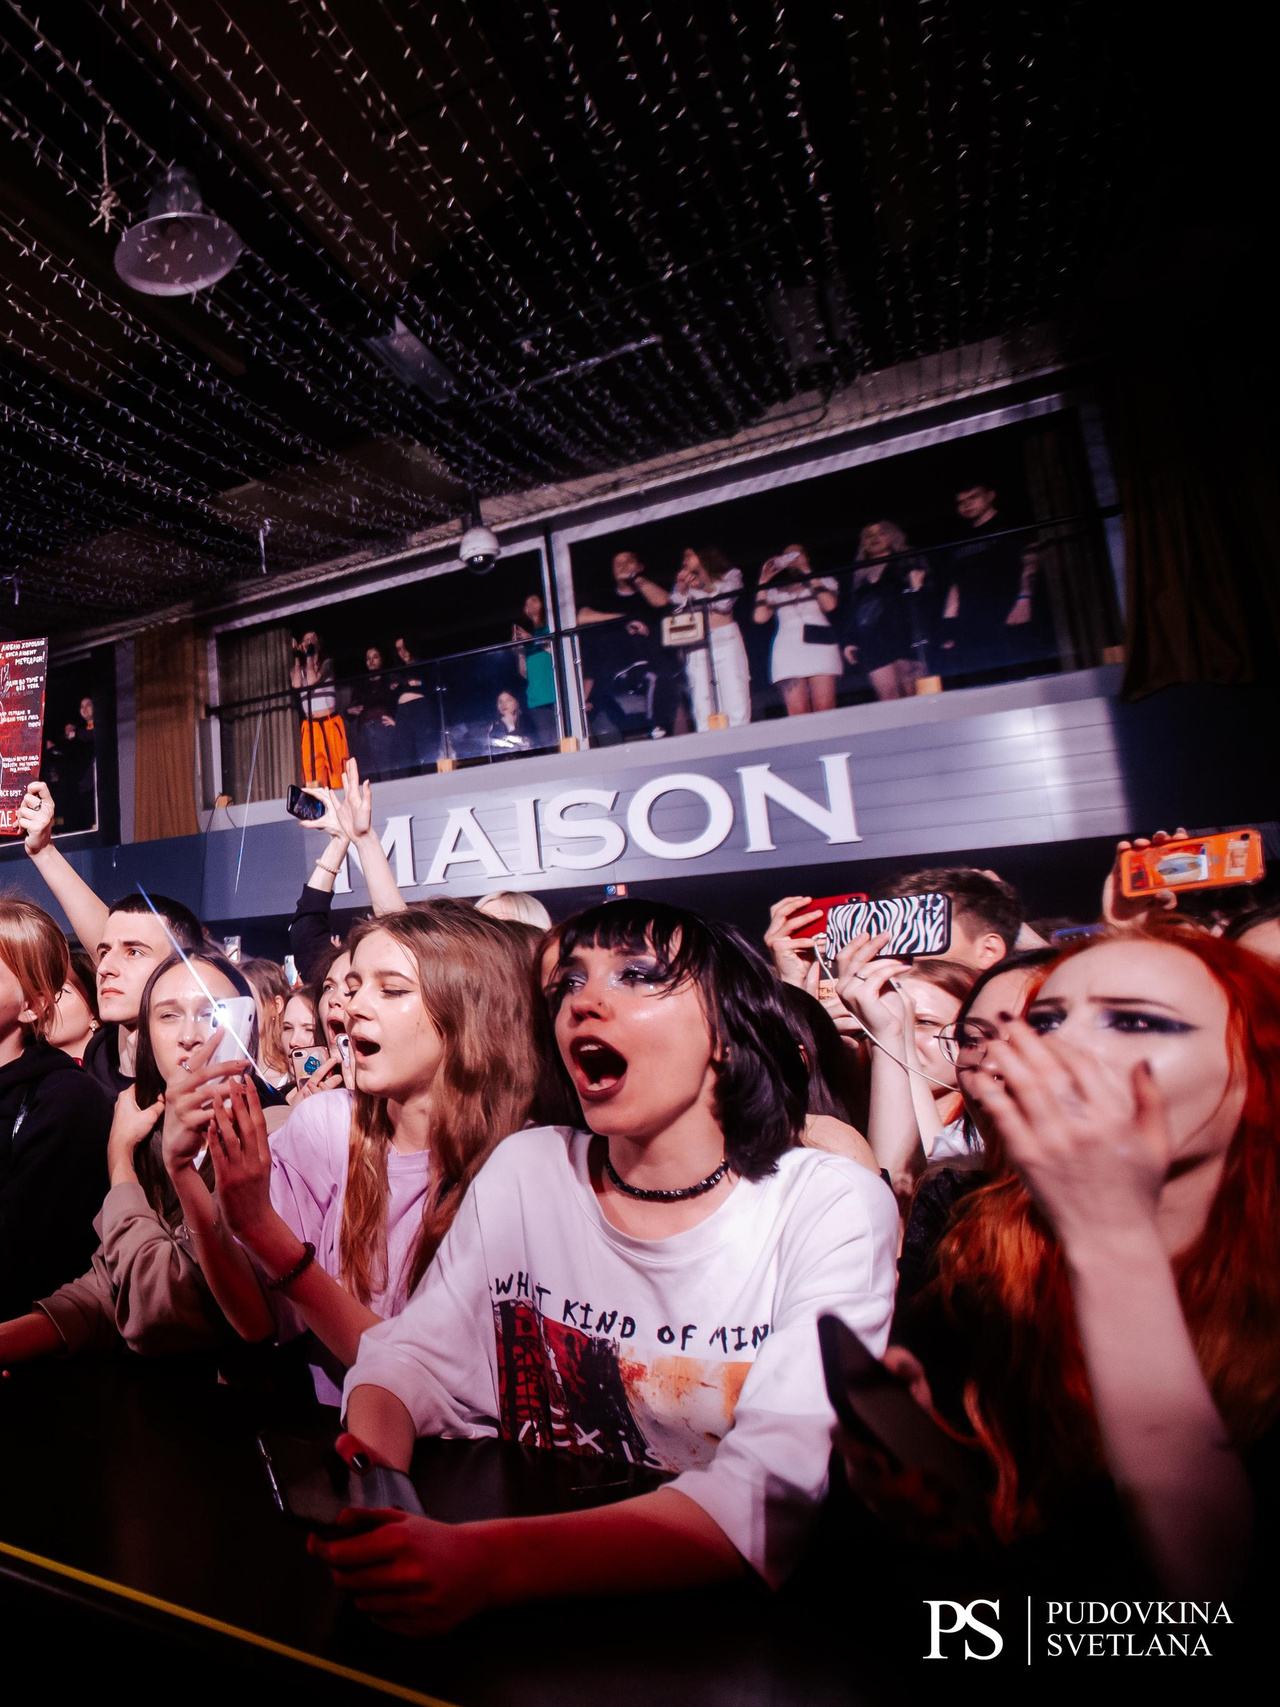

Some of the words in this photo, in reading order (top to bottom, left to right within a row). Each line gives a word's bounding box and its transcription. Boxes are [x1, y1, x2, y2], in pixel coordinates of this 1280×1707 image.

[334, 752, 864, 894] MAISON
[495, 1271, 551, 1310] WHT
[562, 1300, 636, 1338] KIND
[656, 1324, 698, 1351] OF
